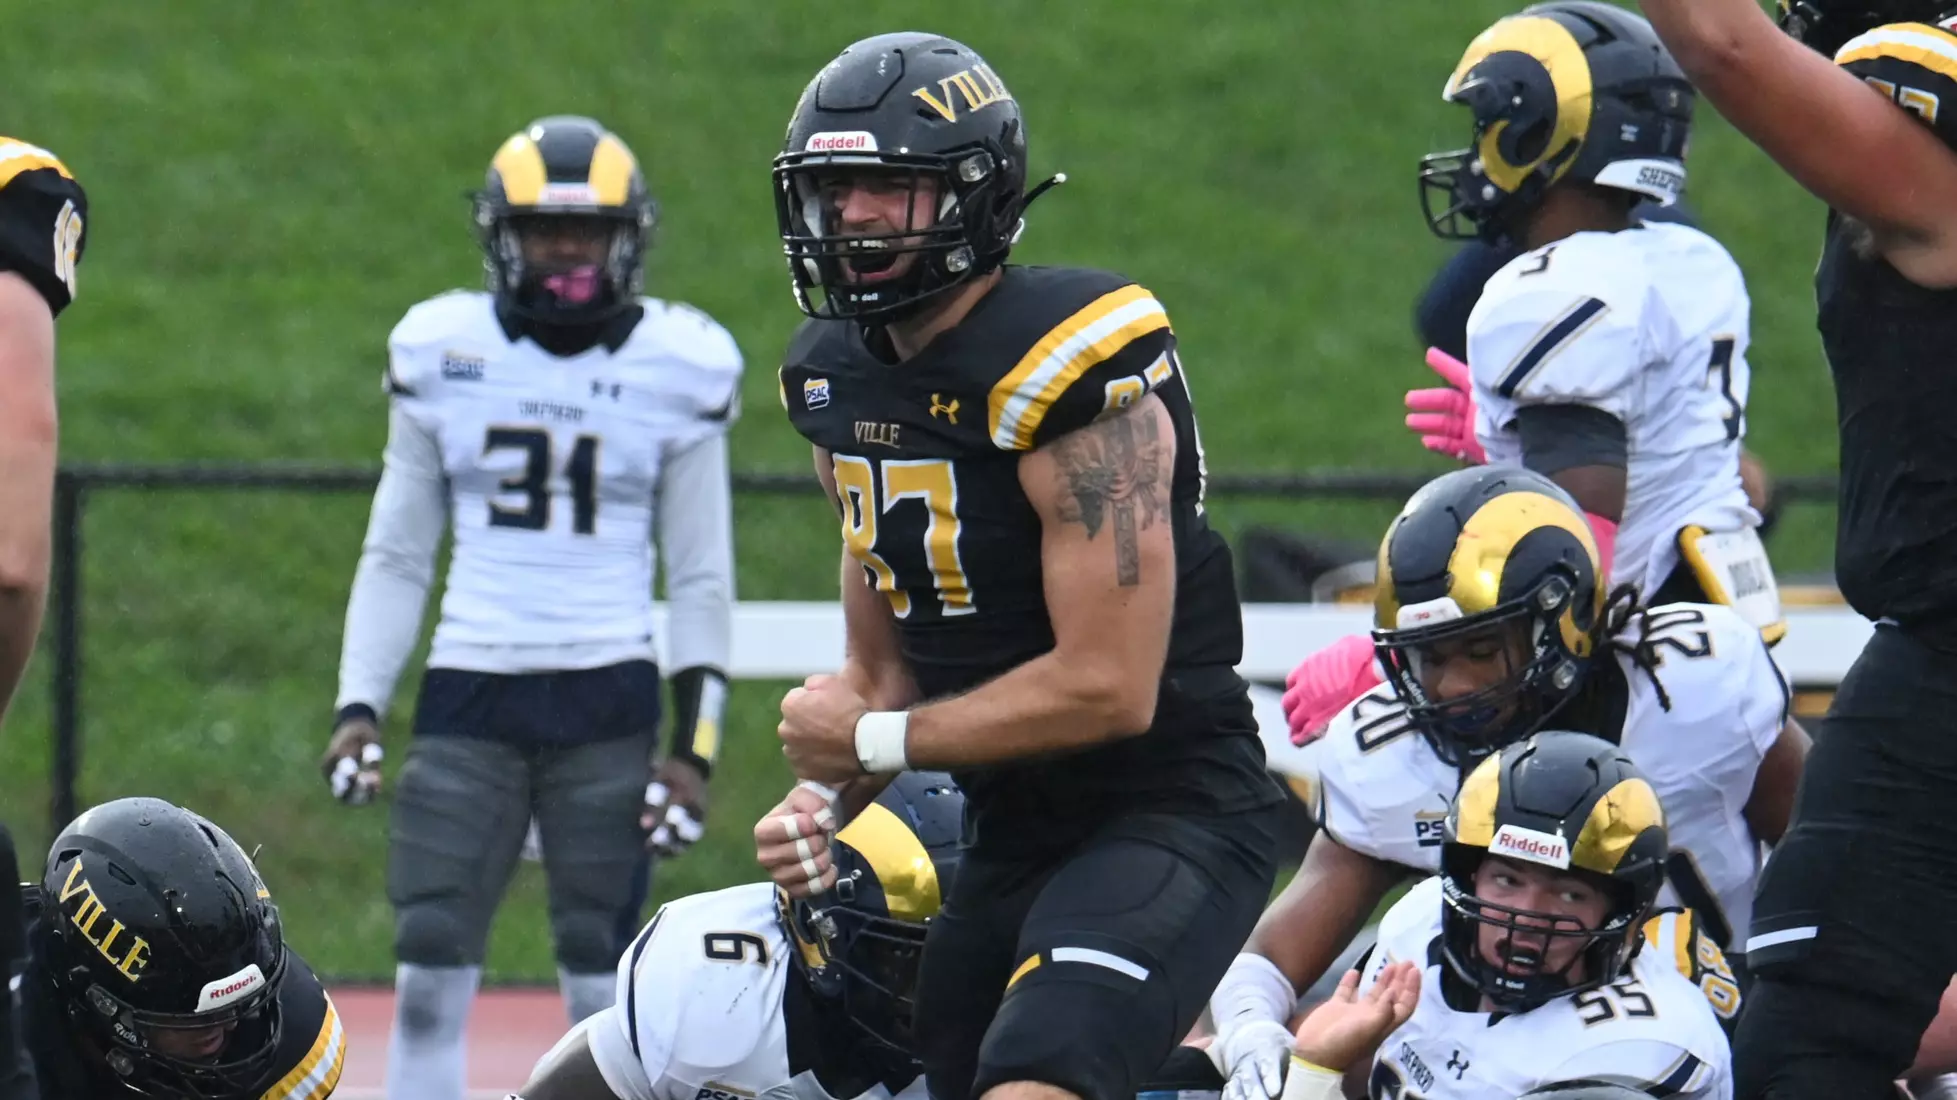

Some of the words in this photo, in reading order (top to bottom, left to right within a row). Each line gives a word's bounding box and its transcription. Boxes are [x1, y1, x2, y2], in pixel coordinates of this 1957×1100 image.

[812, 135, 865, 149] Riddell
[806, 387, 828, 401] PSAC
[854, 420, 901, 448] VILLE
[481, 425, 604, 536] 31
[832, 452, 978, 620] 87
[1351, 693, 1416, 757] 20
[1499, 832, 1564, 859] Riddell
[59, 858, 152, 983] VILLE
[701, 928, 771, 970] 6
[1569, 978, 1658, 1028] 55
[1400, 1042, 1435, 1093] SHEPHERD
